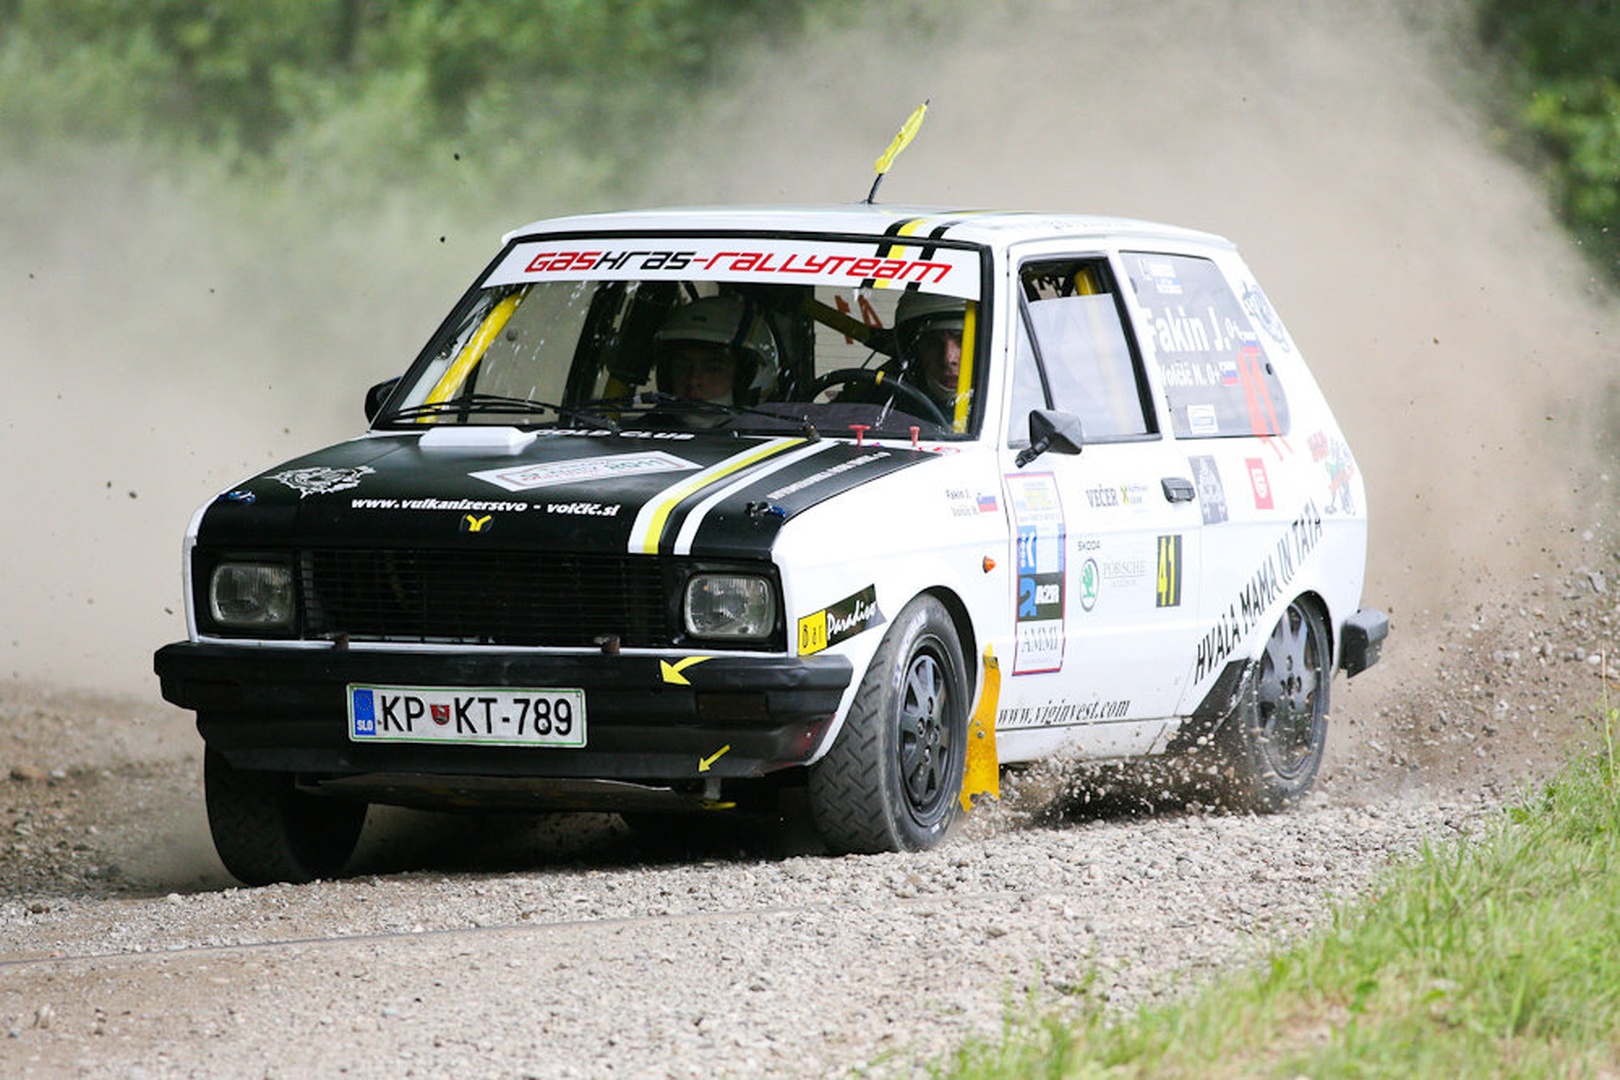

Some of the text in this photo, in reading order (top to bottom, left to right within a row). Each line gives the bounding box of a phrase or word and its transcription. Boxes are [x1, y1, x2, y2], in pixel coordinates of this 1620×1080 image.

[1193, 603, 1241, 686] HVALA
[1239, 553, 1283, 636] MAMA
[1277, 530, 1296, 586] IN
[356, 695, 573, 736] SLO KP KT-789
